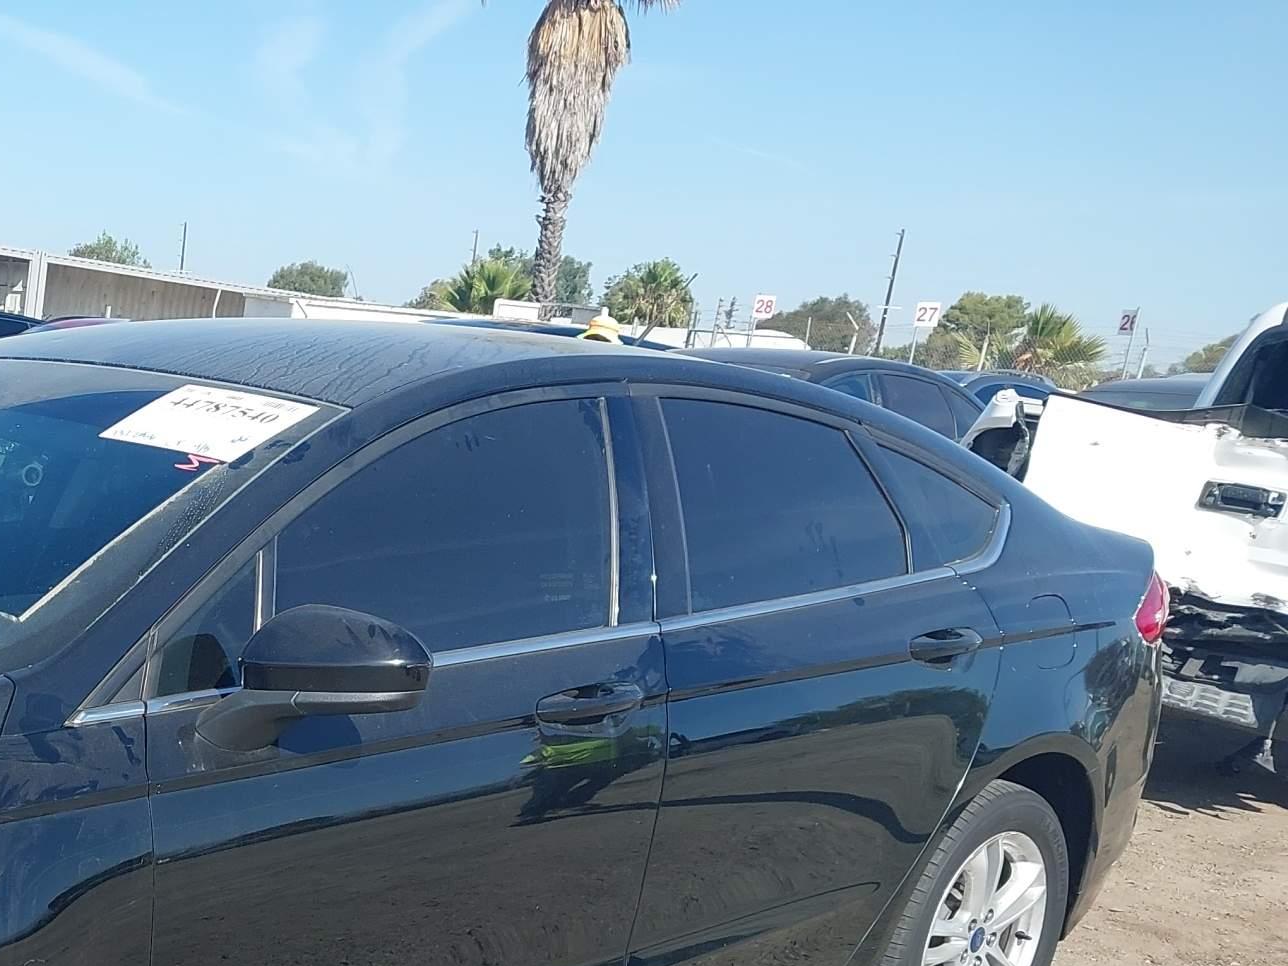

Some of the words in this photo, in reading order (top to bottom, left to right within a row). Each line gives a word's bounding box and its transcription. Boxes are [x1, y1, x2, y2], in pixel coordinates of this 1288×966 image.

[755, 299, 775, 315] 28
[916, 306, 939, 323] 27
[170, 397, 280, 423] 44787540
